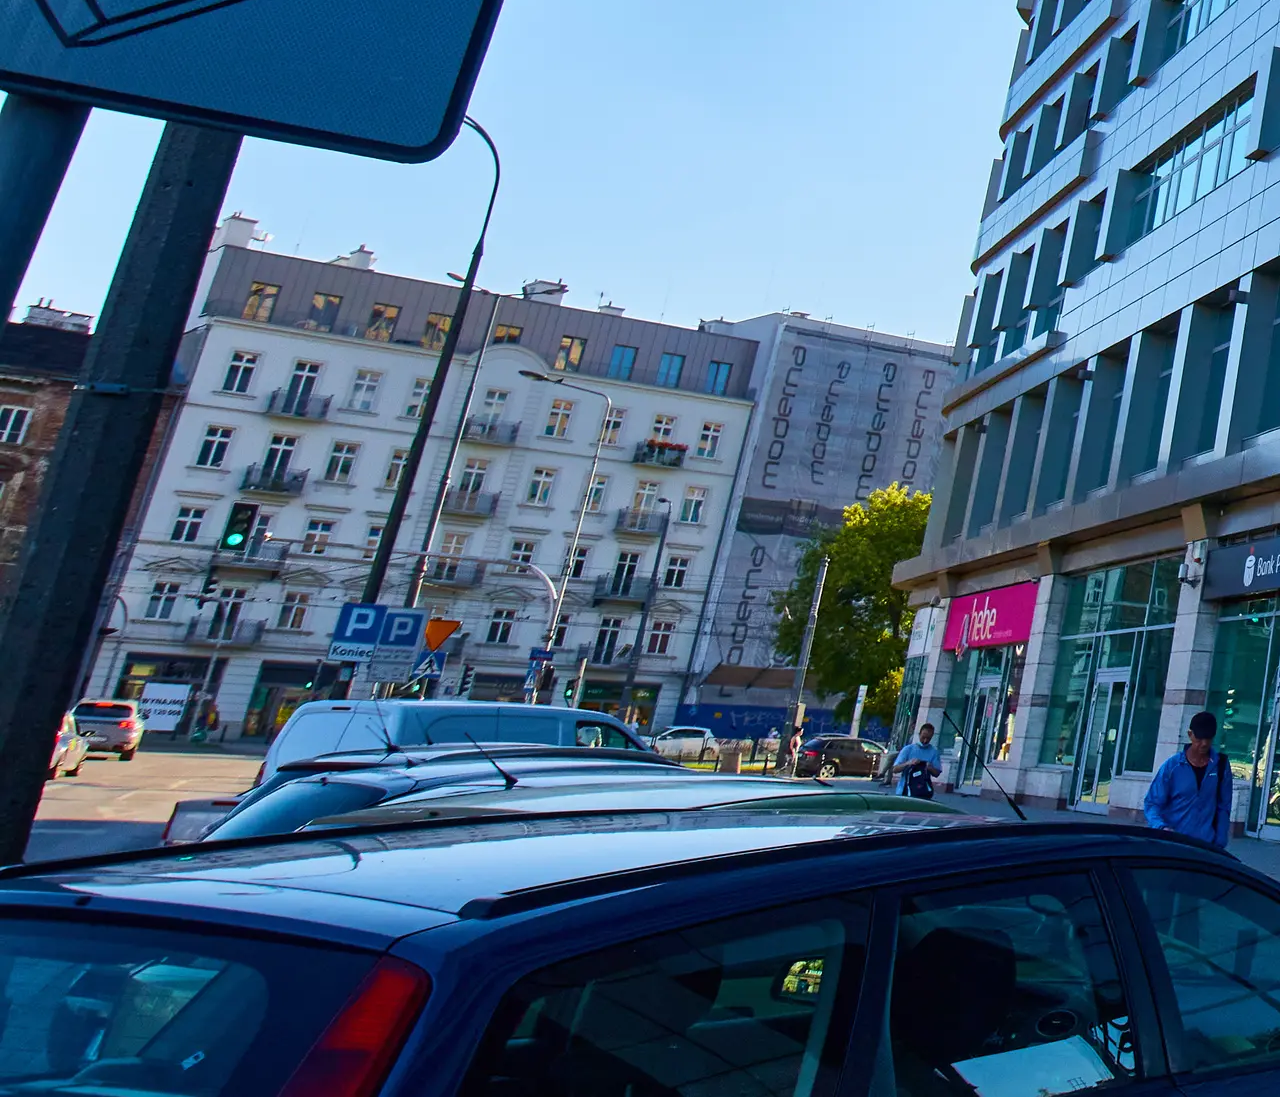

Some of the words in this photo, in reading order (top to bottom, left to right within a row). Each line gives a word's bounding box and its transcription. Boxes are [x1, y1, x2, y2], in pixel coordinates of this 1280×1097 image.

[762, 345, 807, 490] moderna
[811, 360, 851, 486] moderna
[855, 362, 897, 501] moderna
[1257, 555, 1275, 577] Bank
[345, 607, 377, 637] P
[388, 617, 414, 642] P
[718, 545, 766, 697] oderna
[968, 596, 997, 641] hebe
[331, 645, 373, 659] Koniec
